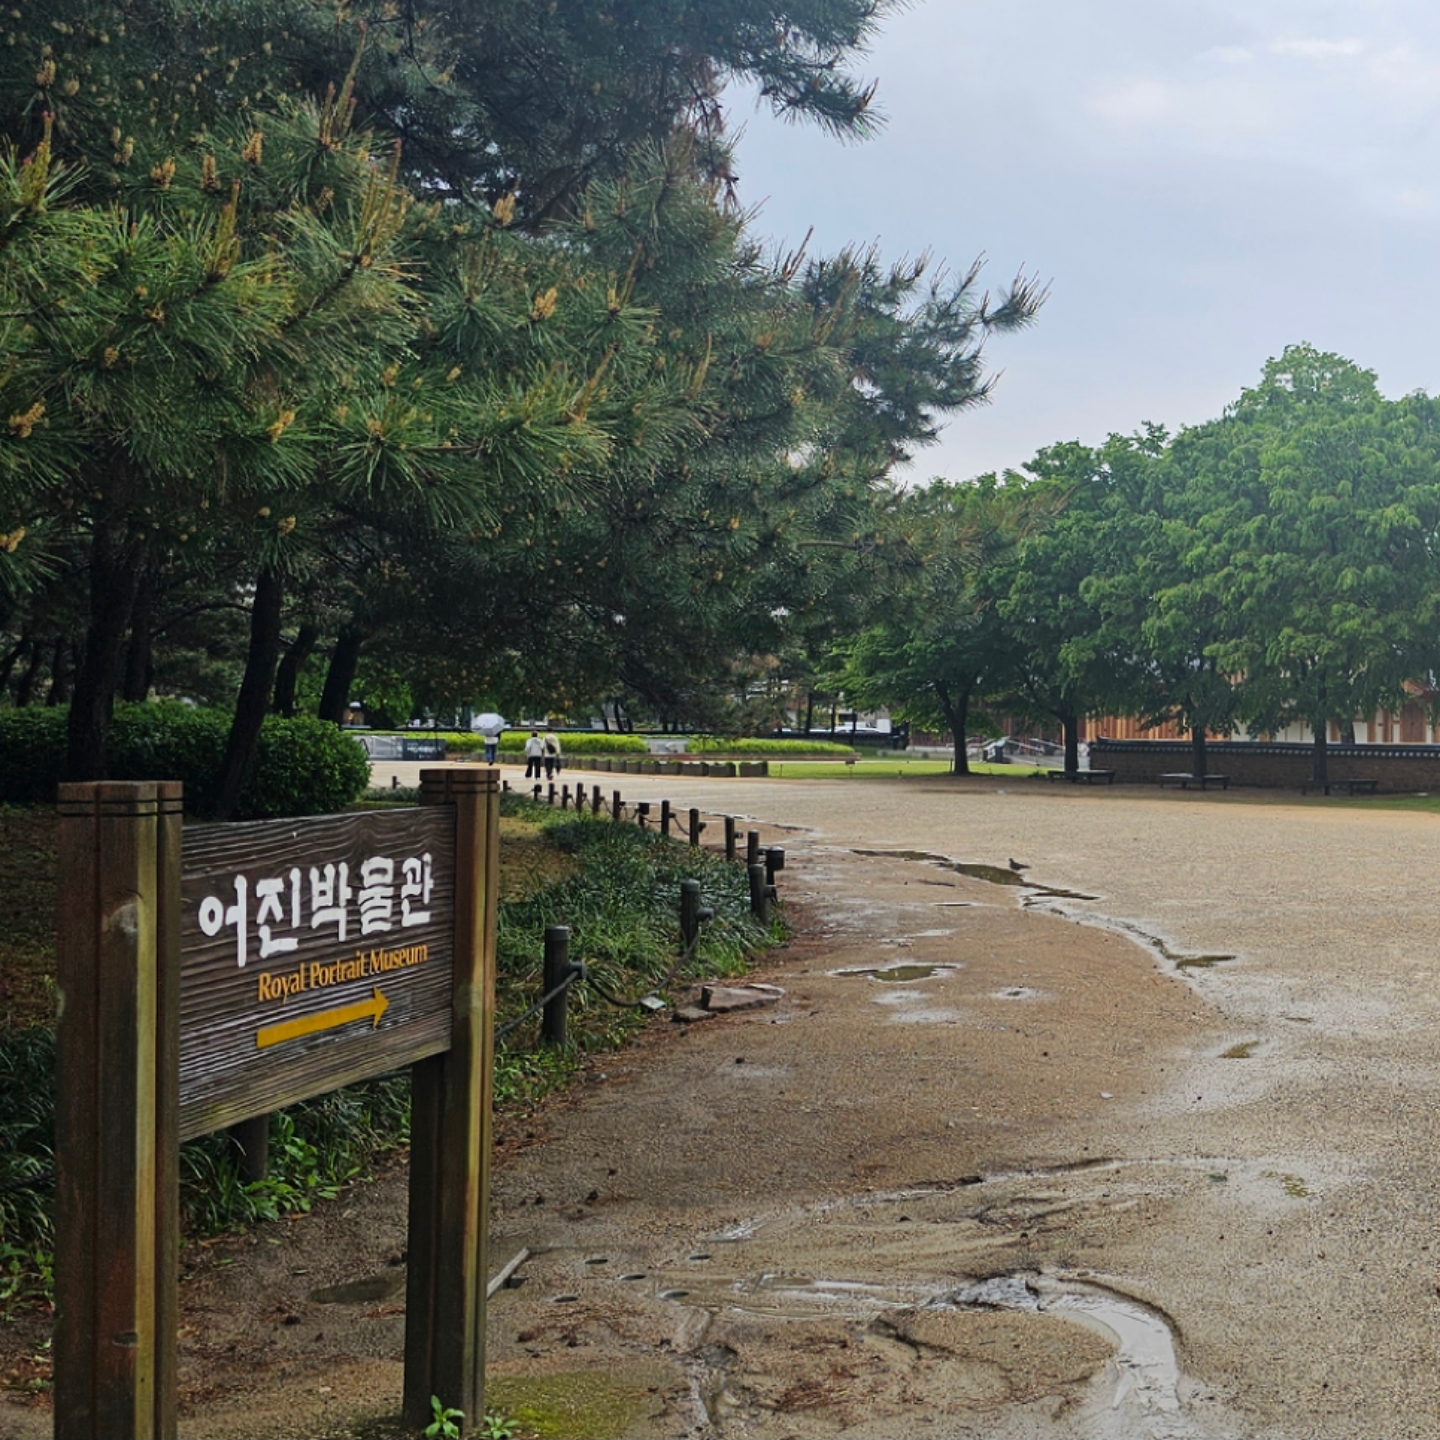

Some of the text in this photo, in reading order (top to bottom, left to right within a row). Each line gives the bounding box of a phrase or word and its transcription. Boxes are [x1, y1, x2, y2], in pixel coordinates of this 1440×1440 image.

[198, 852, 434, 968] 어진박물관
[258, 944, 428, 1004] Royal Portrait Museum
